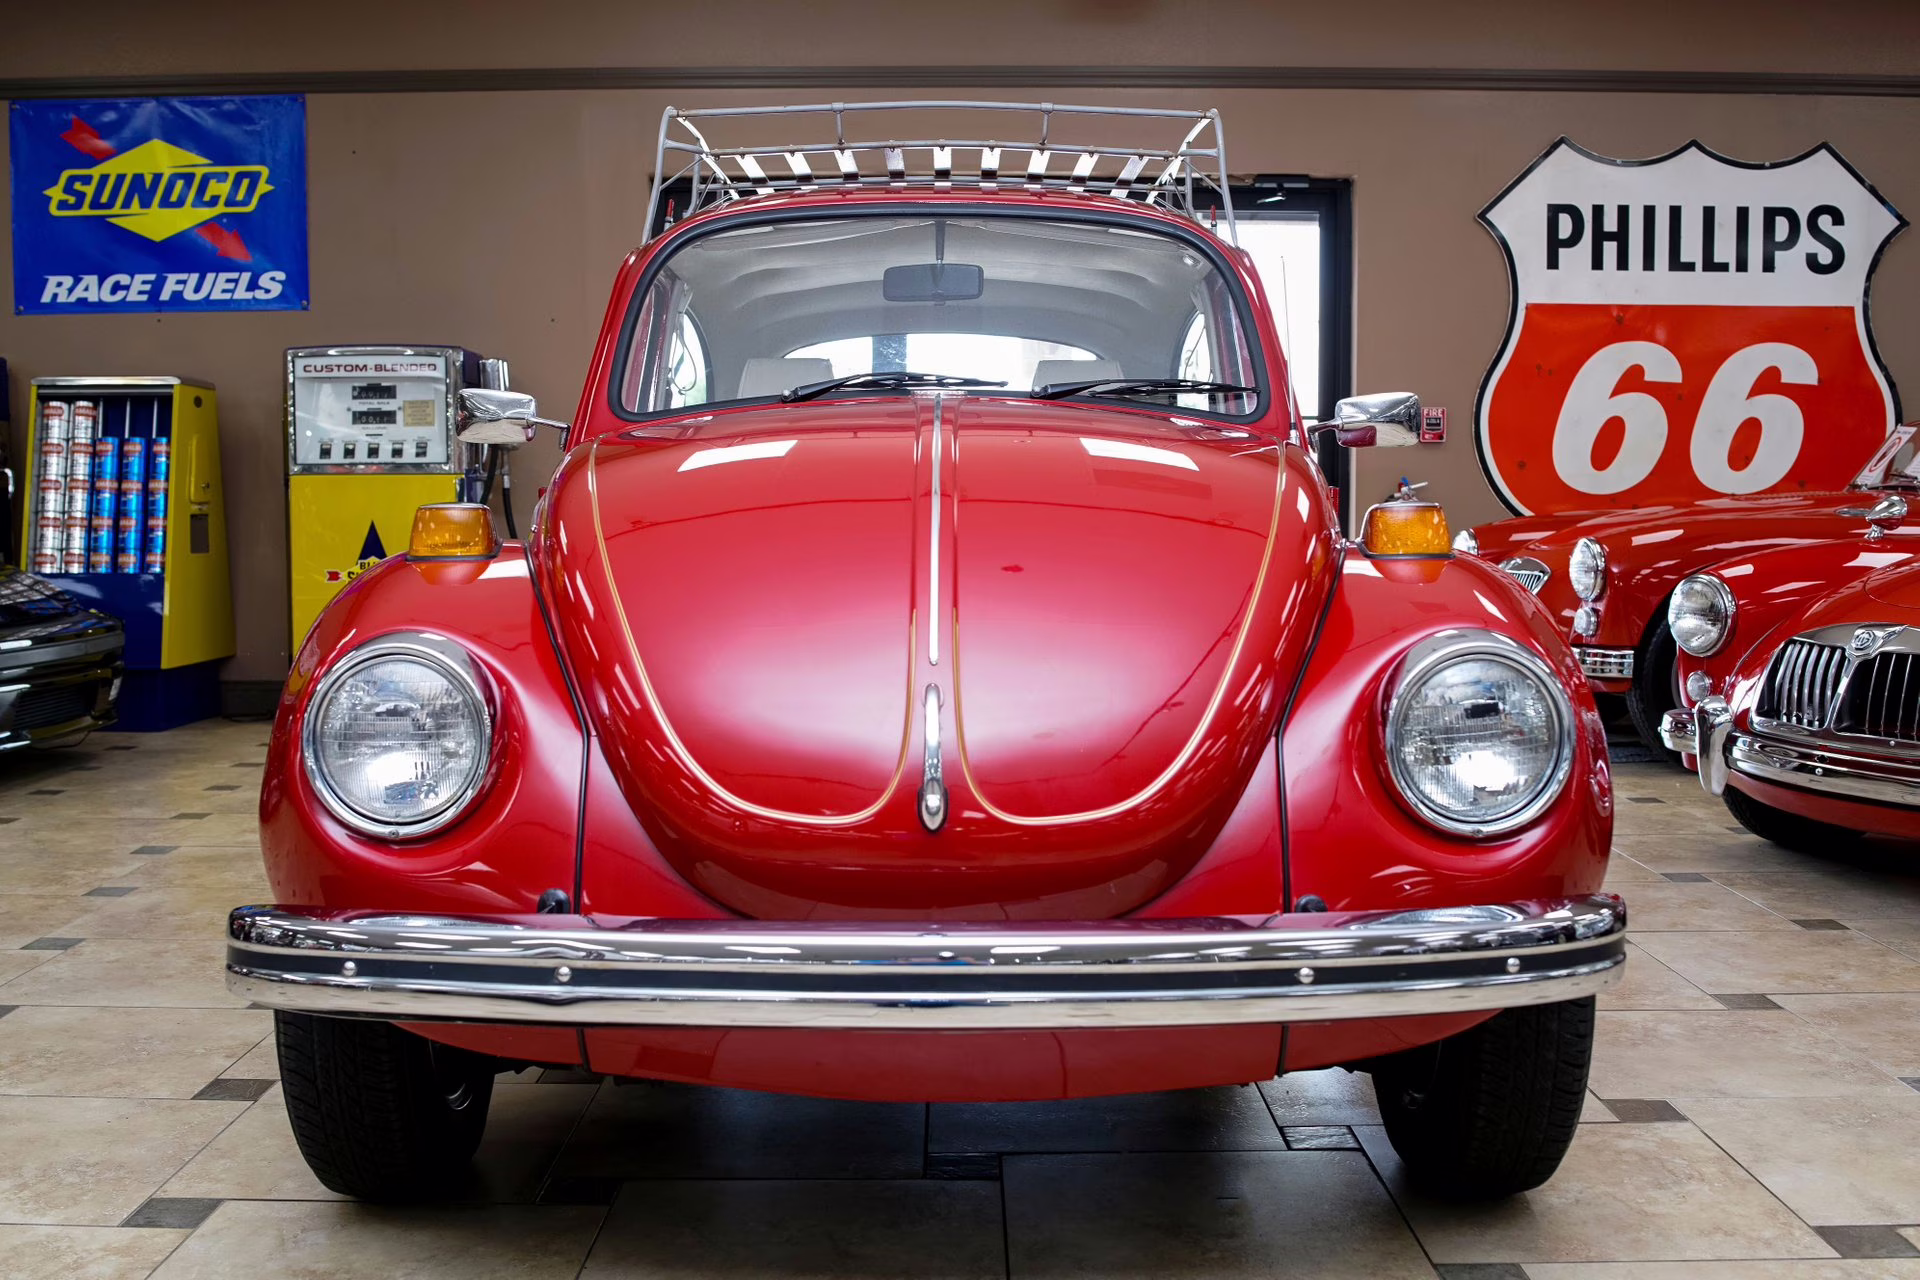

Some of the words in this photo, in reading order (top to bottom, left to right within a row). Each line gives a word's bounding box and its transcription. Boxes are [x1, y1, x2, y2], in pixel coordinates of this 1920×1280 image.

[56, 170, 263, 211] SUNOCO
[1546, 203, 1846, 275] PHILLIPS
[40, 273, 157, 303] RACE
[159, 271, 287, 301] FUELS
[1423, 408, 1443, 417] FIRE
[1552, 341, 1819, 495] 66
